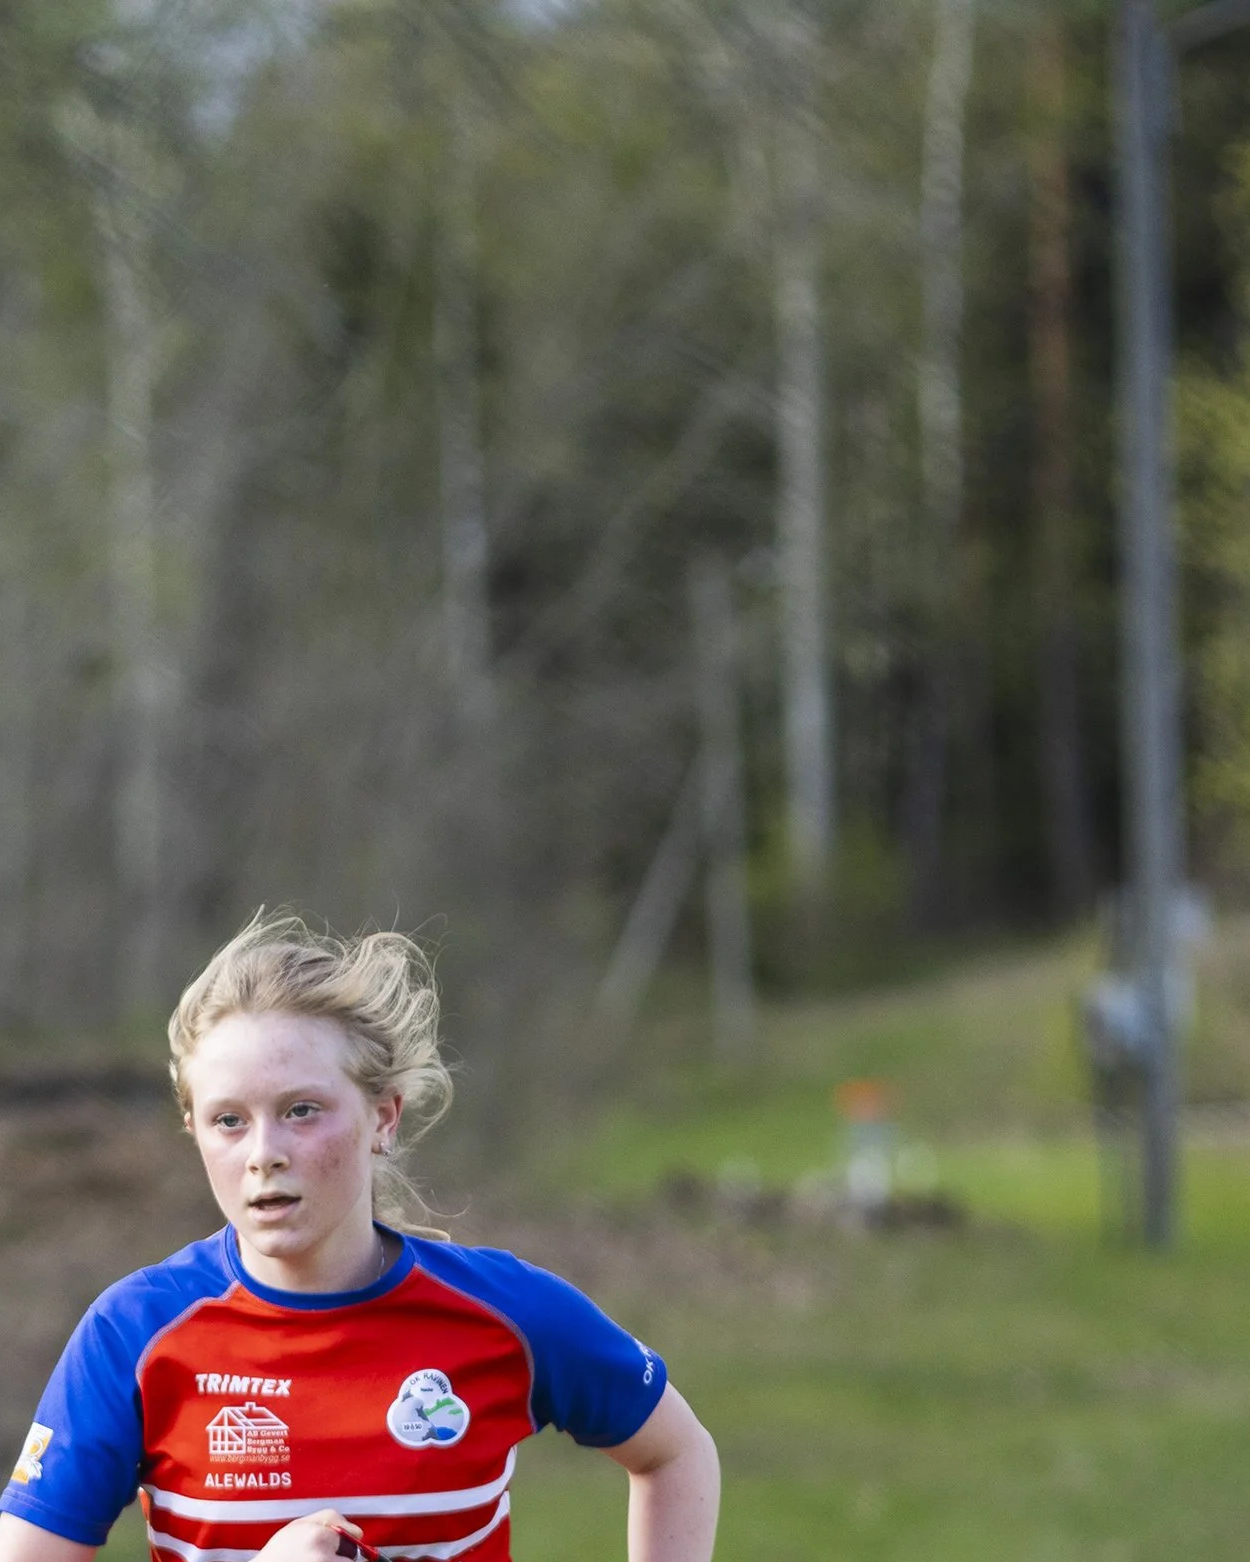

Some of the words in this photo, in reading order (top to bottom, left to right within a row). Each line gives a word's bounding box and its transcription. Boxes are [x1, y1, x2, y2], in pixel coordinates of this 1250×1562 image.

[195, 1373, 292, 1396] TRIMTEX
[410, 1376, 420, 1385] OK
[246, 1438, 284, 1446] Bergman
[278, 1444, 290, 1453] Co
[205, 1472, 292, 1488] ALEWALDS
